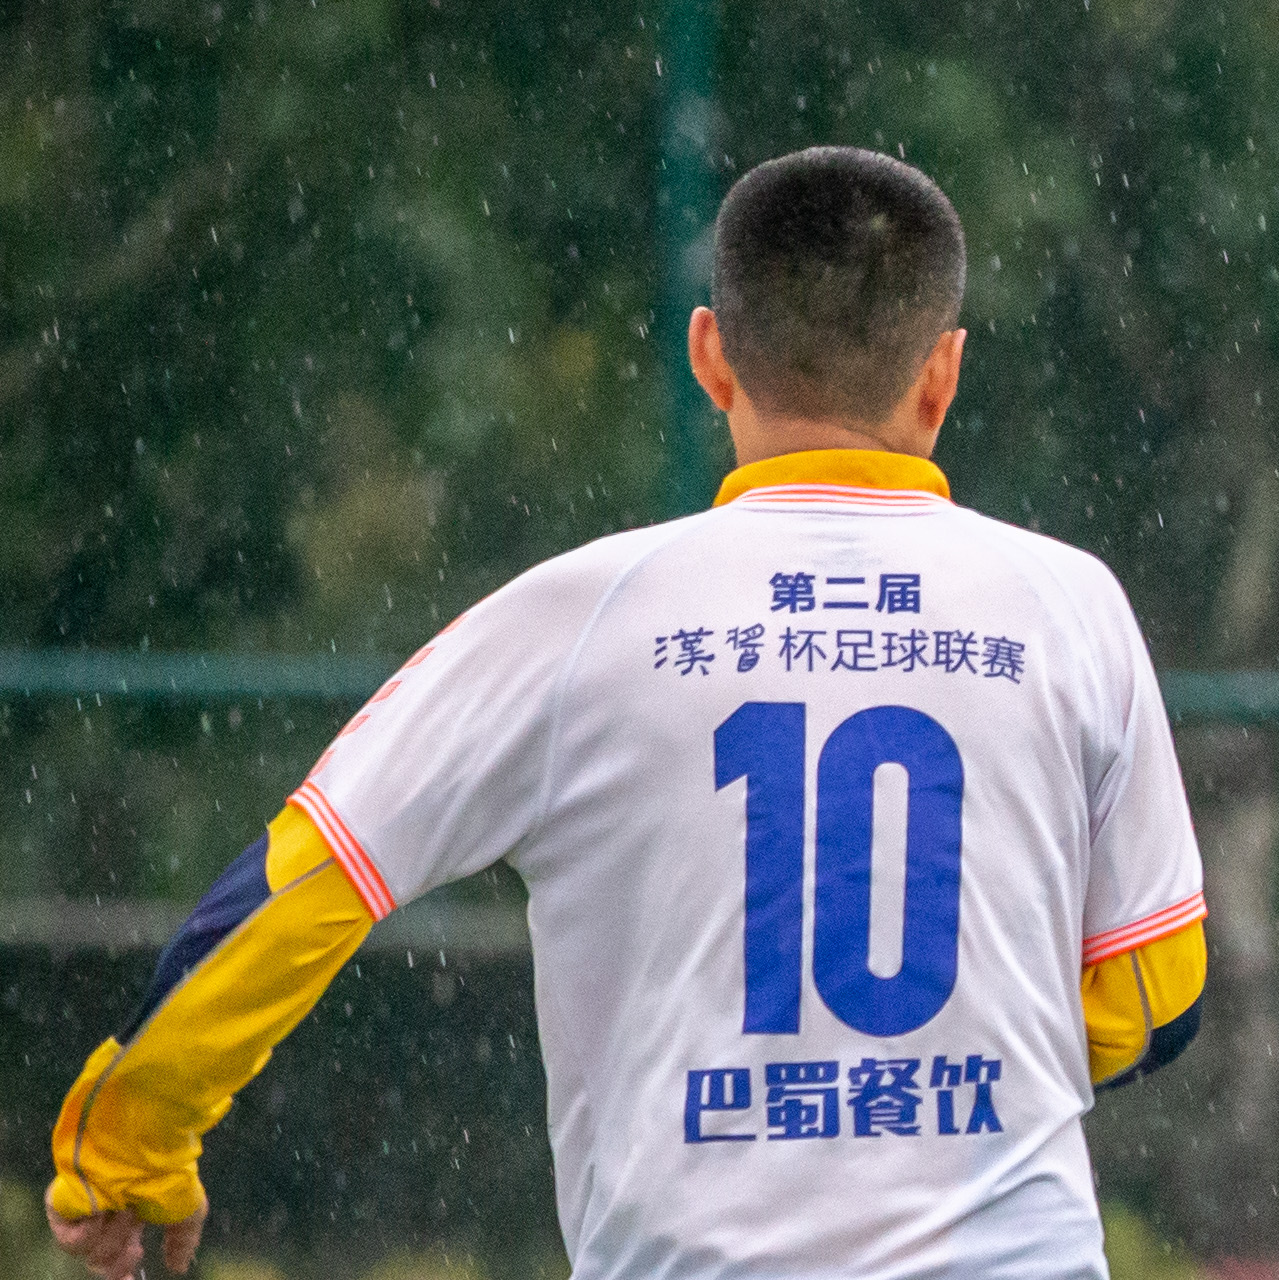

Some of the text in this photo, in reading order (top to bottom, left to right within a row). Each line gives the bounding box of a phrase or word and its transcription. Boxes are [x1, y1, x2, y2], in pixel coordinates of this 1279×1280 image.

[769, 572, 921, 614] 第二届
[713, 701, 965, 1038] 10
[684, 1054, 1004, 1144] 巴蜀餐饮
